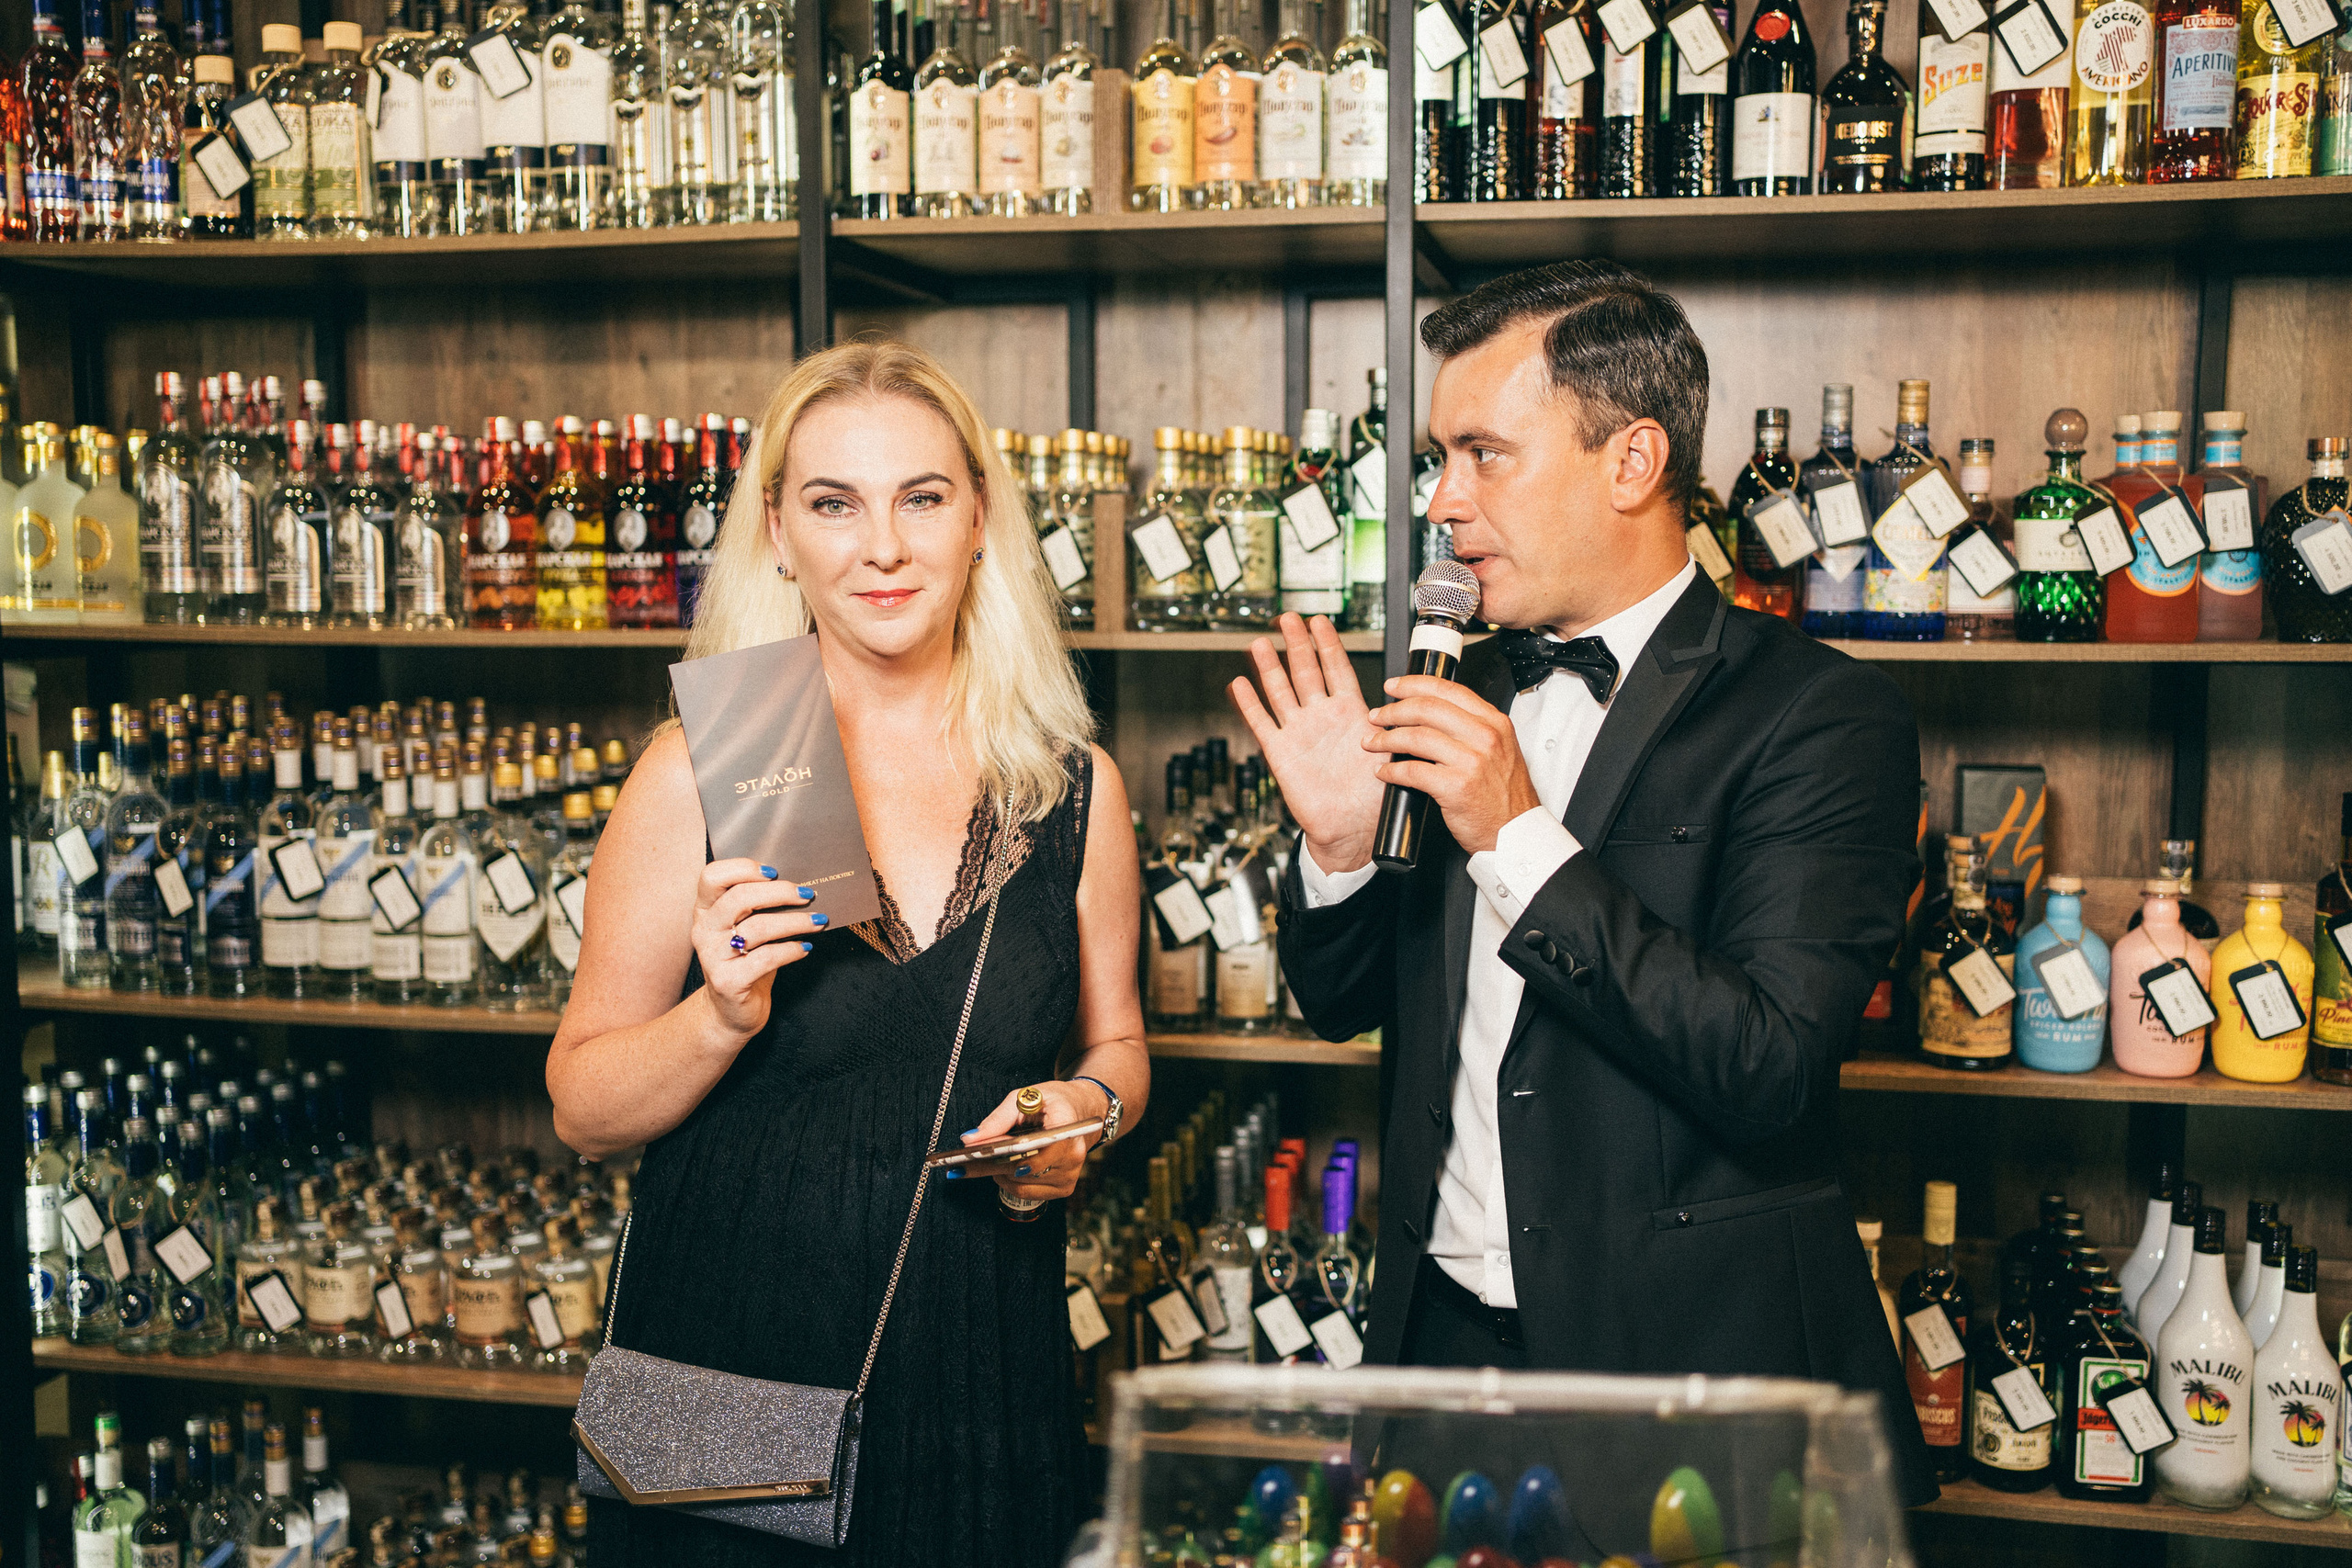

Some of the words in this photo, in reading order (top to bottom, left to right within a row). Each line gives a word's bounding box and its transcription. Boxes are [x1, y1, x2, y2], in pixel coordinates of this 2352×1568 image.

[2094, 12, 2142, 29] COCCHI
[2186, 17, 2234, 28] LUXARDO
[2081, 61, 2148, 87] AMERICANO
[1834, 120, 1894, 140] HEDONIST
[734, 766, 812, 794] ЭТАЛОН
[762, 786, 790, 797] GOLD
[829, 870, 855, 882] ПОКУПКУ
[2052, 1031, 2082, 1043] RUM
[2170, 1358, 2246, 1386] MALIBU
[2267, 1380, 2337, 1406] MALIBU
